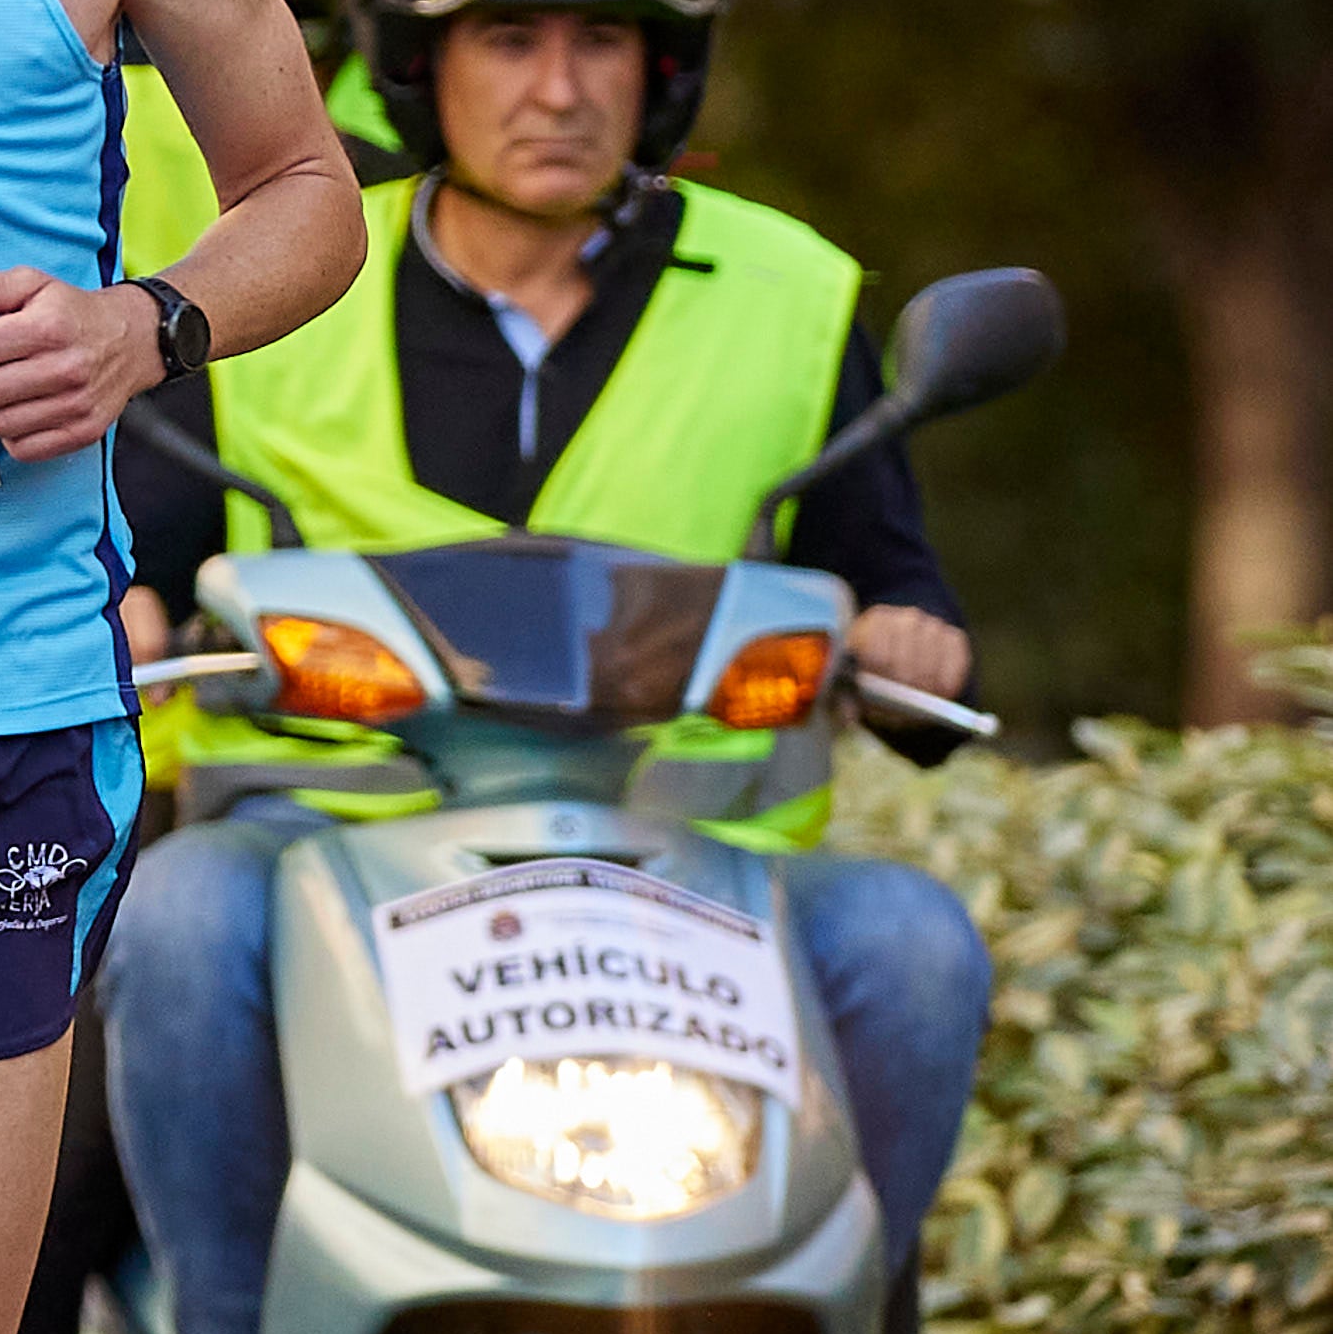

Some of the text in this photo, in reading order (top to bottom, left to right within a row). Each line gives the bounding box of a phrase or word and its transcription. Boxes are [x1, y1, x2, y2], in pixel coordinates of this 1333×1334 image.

[7, 843, 68, 870] CMD
[451, 946, 741, 1006] VEHÍCULO
[426, 998, 788, 1069] AUTORIZADO
